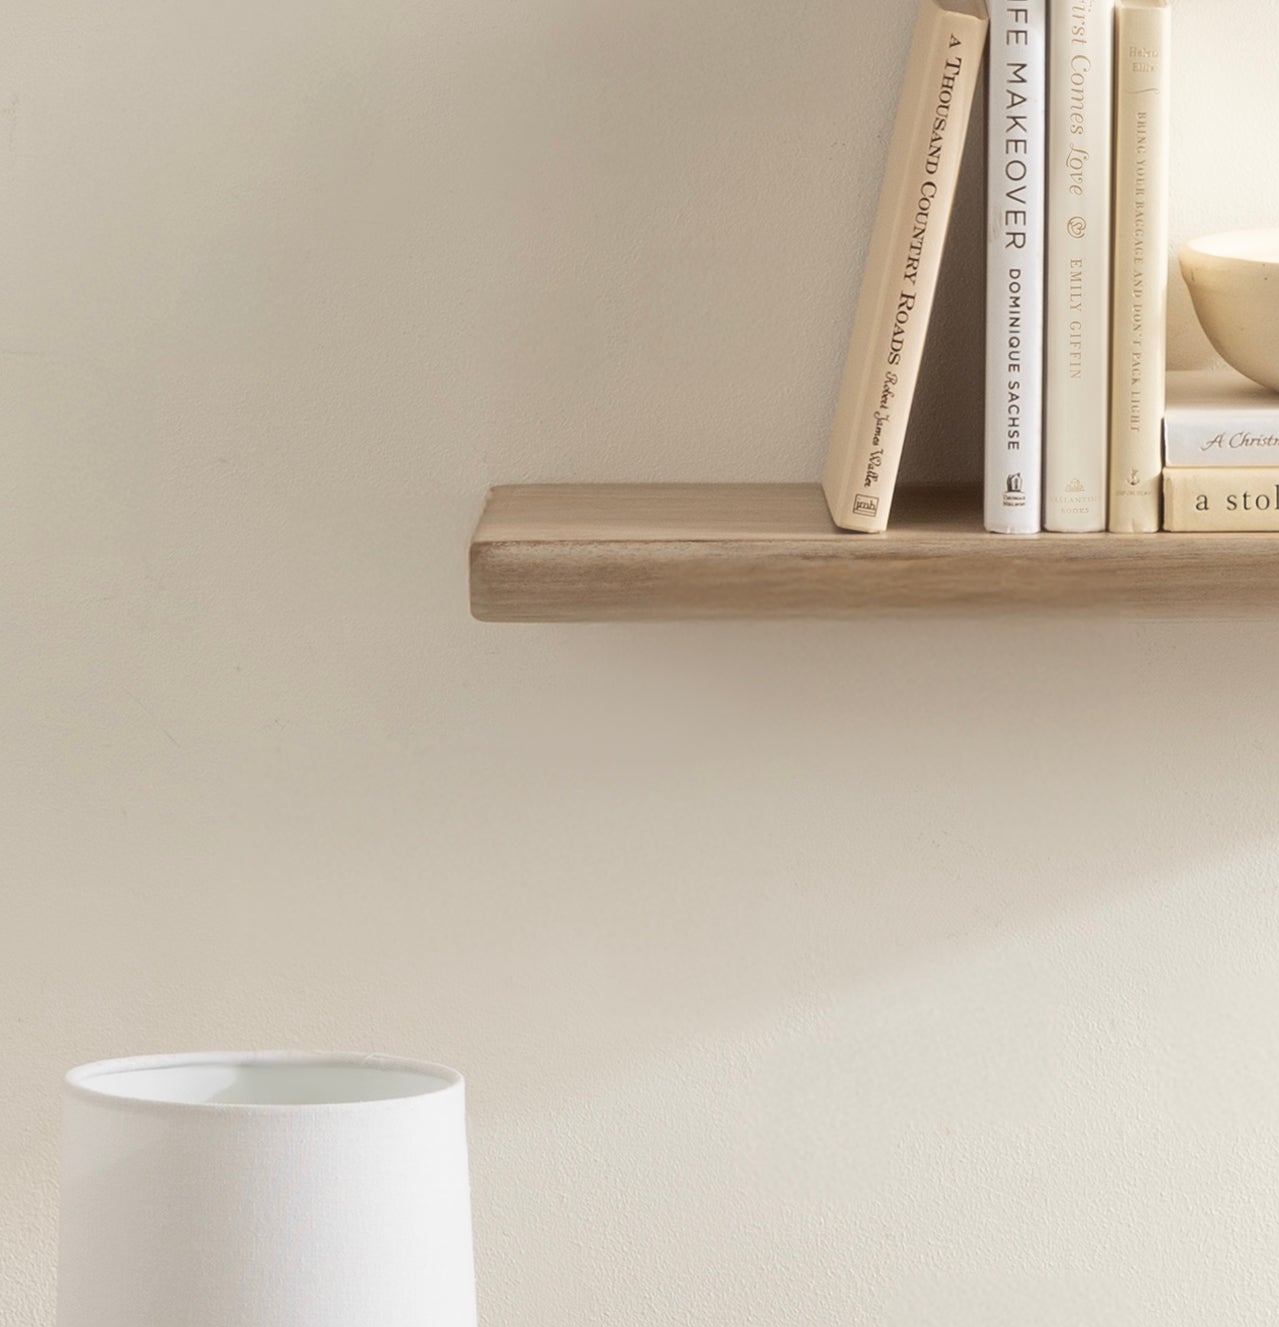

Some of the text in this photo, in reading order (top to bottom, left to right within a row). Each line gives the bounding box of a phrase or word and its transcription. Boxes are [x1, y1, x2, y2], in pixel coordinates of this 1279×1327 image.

[1070, 54, 1092, 135] Comes
[1005, 63, 1028, 249] MAKEOVER
[1136, 112, 1148, 155] BRING
[1065, 142, 1090, 197] Love
[1135, 159, 1147, 196] YOUR
[887, 33, 962, 366] A THOUSAND COUNTRY ROADS
[1133, 201, 1146, 265] BAGGAGE
[1132, 272, 1144, 299] AND
[1069, 259, 1083, 380] EMILY GIFFIN
[1007, 268, 1022, 450] DOMINIQUE SACHSE
[1130, 352, 1142, 386] PACK
[864, 371, 898, 488] Robert James Waller
[1130, 391, 1142, 433] LIGHT
[1200, 433, 1224, 451] A
[1195, 493, 1209, 511] a
